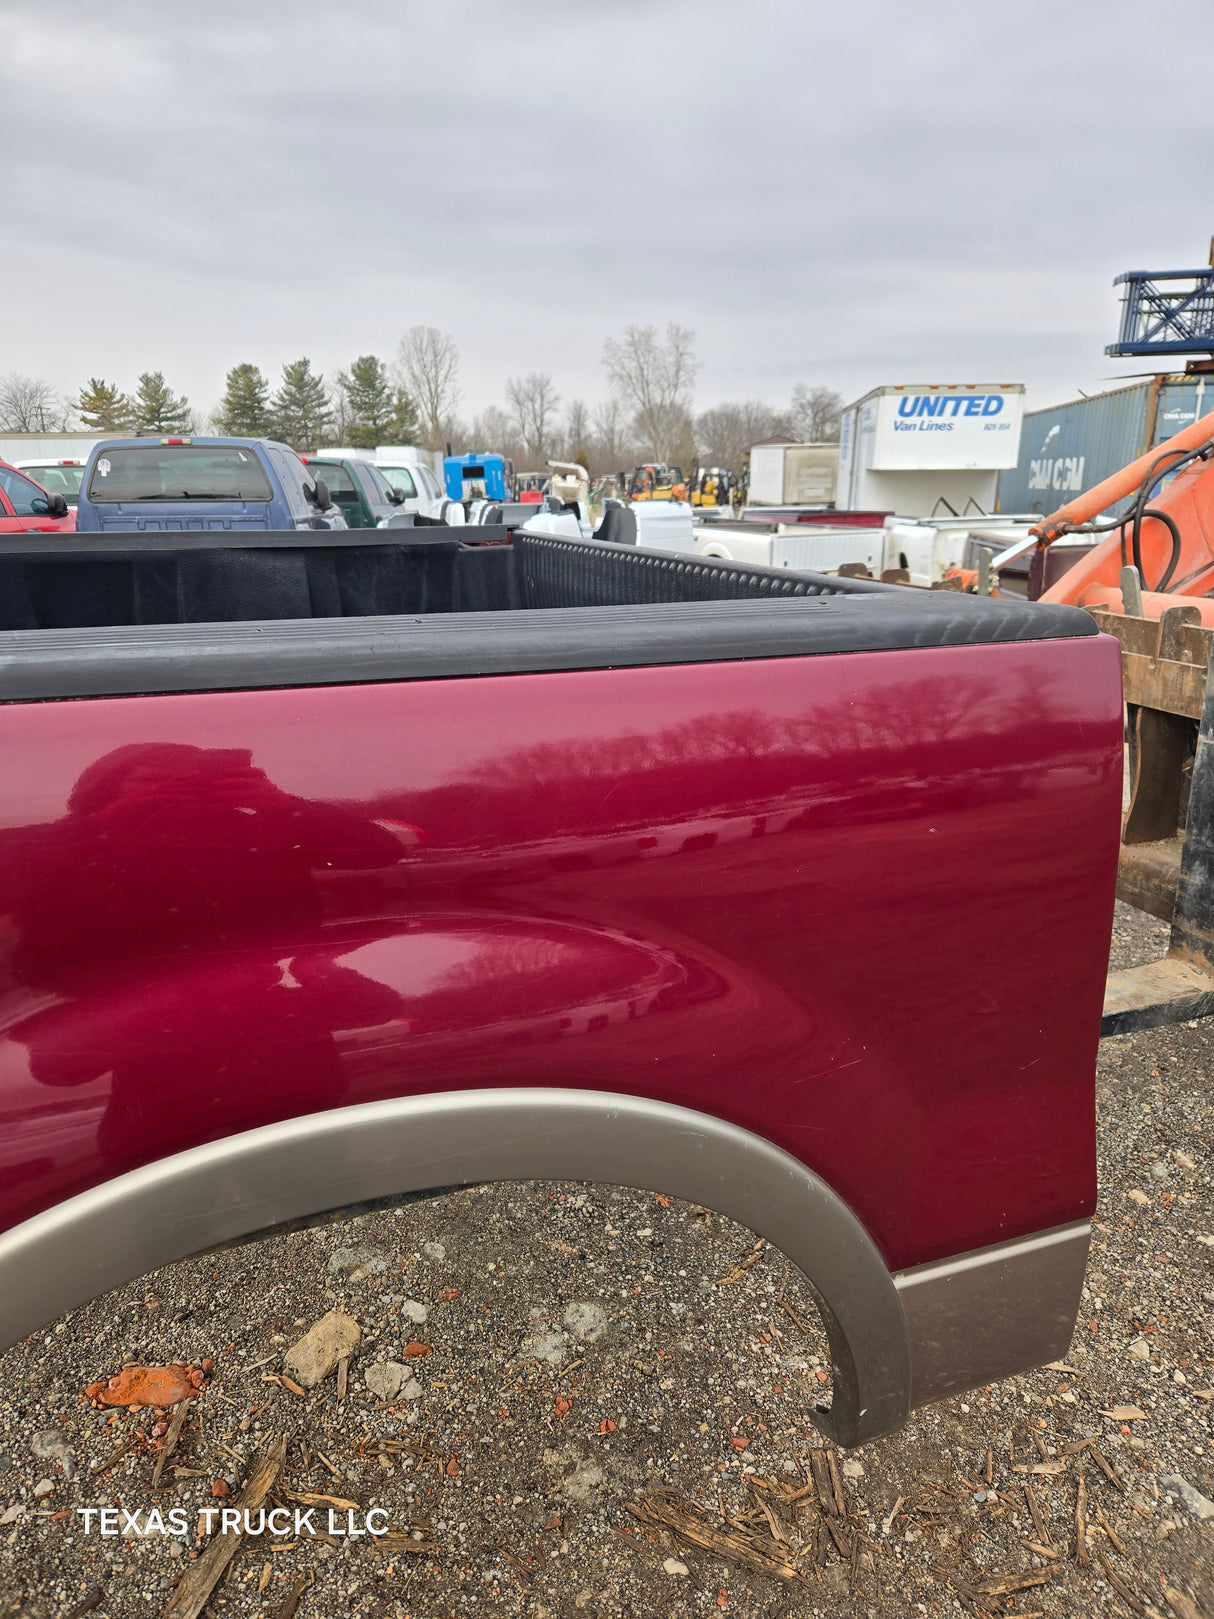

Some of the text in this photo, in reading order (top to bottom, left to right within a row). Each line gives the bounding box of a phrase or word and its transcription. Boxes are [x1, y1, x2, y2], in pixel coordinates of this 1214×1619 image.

[897, 395, 1004, 417] UNITED
[893, 420, 954, 431] Van Lines
